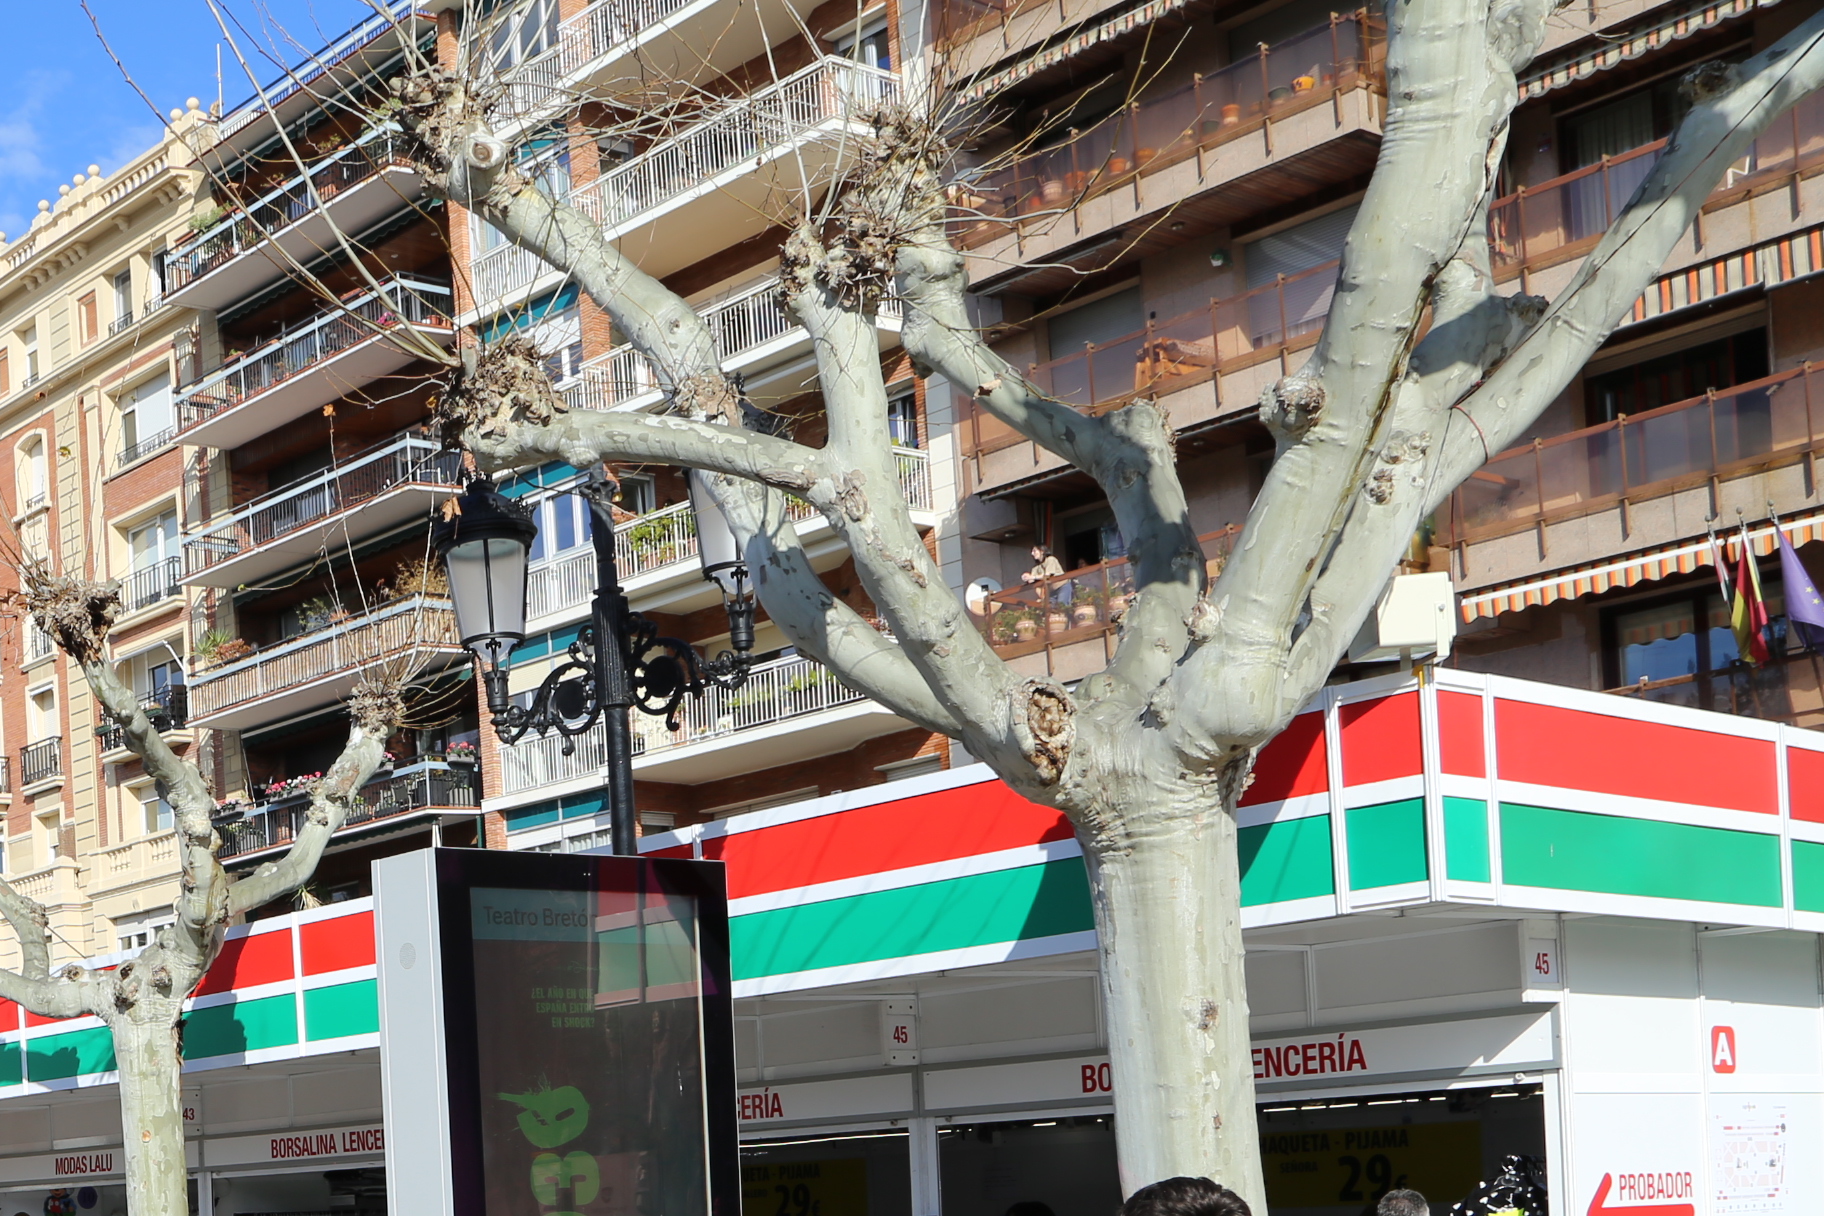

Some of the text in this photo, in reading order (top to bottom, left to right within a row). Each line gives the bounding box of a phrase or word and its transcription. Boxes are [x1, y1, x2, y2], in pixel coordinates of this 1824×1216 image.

[483, 906, 538, 927] Teatro
[1535, 952, 1550, 975] 45
[547, 985, 564, 999] AÑO
[566, 988, 577, 999] EN
[578, 988, 594, 999] QUE
[536, 1000, 567, 1013] ESPAÑA
[551, 1016, 596, 1028] EN SHOCK?
[893, 1026, 908, 1043] 45
[1713, 1032, 1733, 1066] A
[182, 1107, 195, 1121] 43
[270, 1128, 384, 1159] BORSALINA LENCE
[1345, 1128, 1409, 1150] PIJAMA
[55, 1153, 112, 1176] MODAS LALU
[779, 1163, 820, 1180] PIJAMA
[1280, 1160, 1318, 1174] SEÑORA
[1619, 1171, 1693, 1201] PROBADOR
